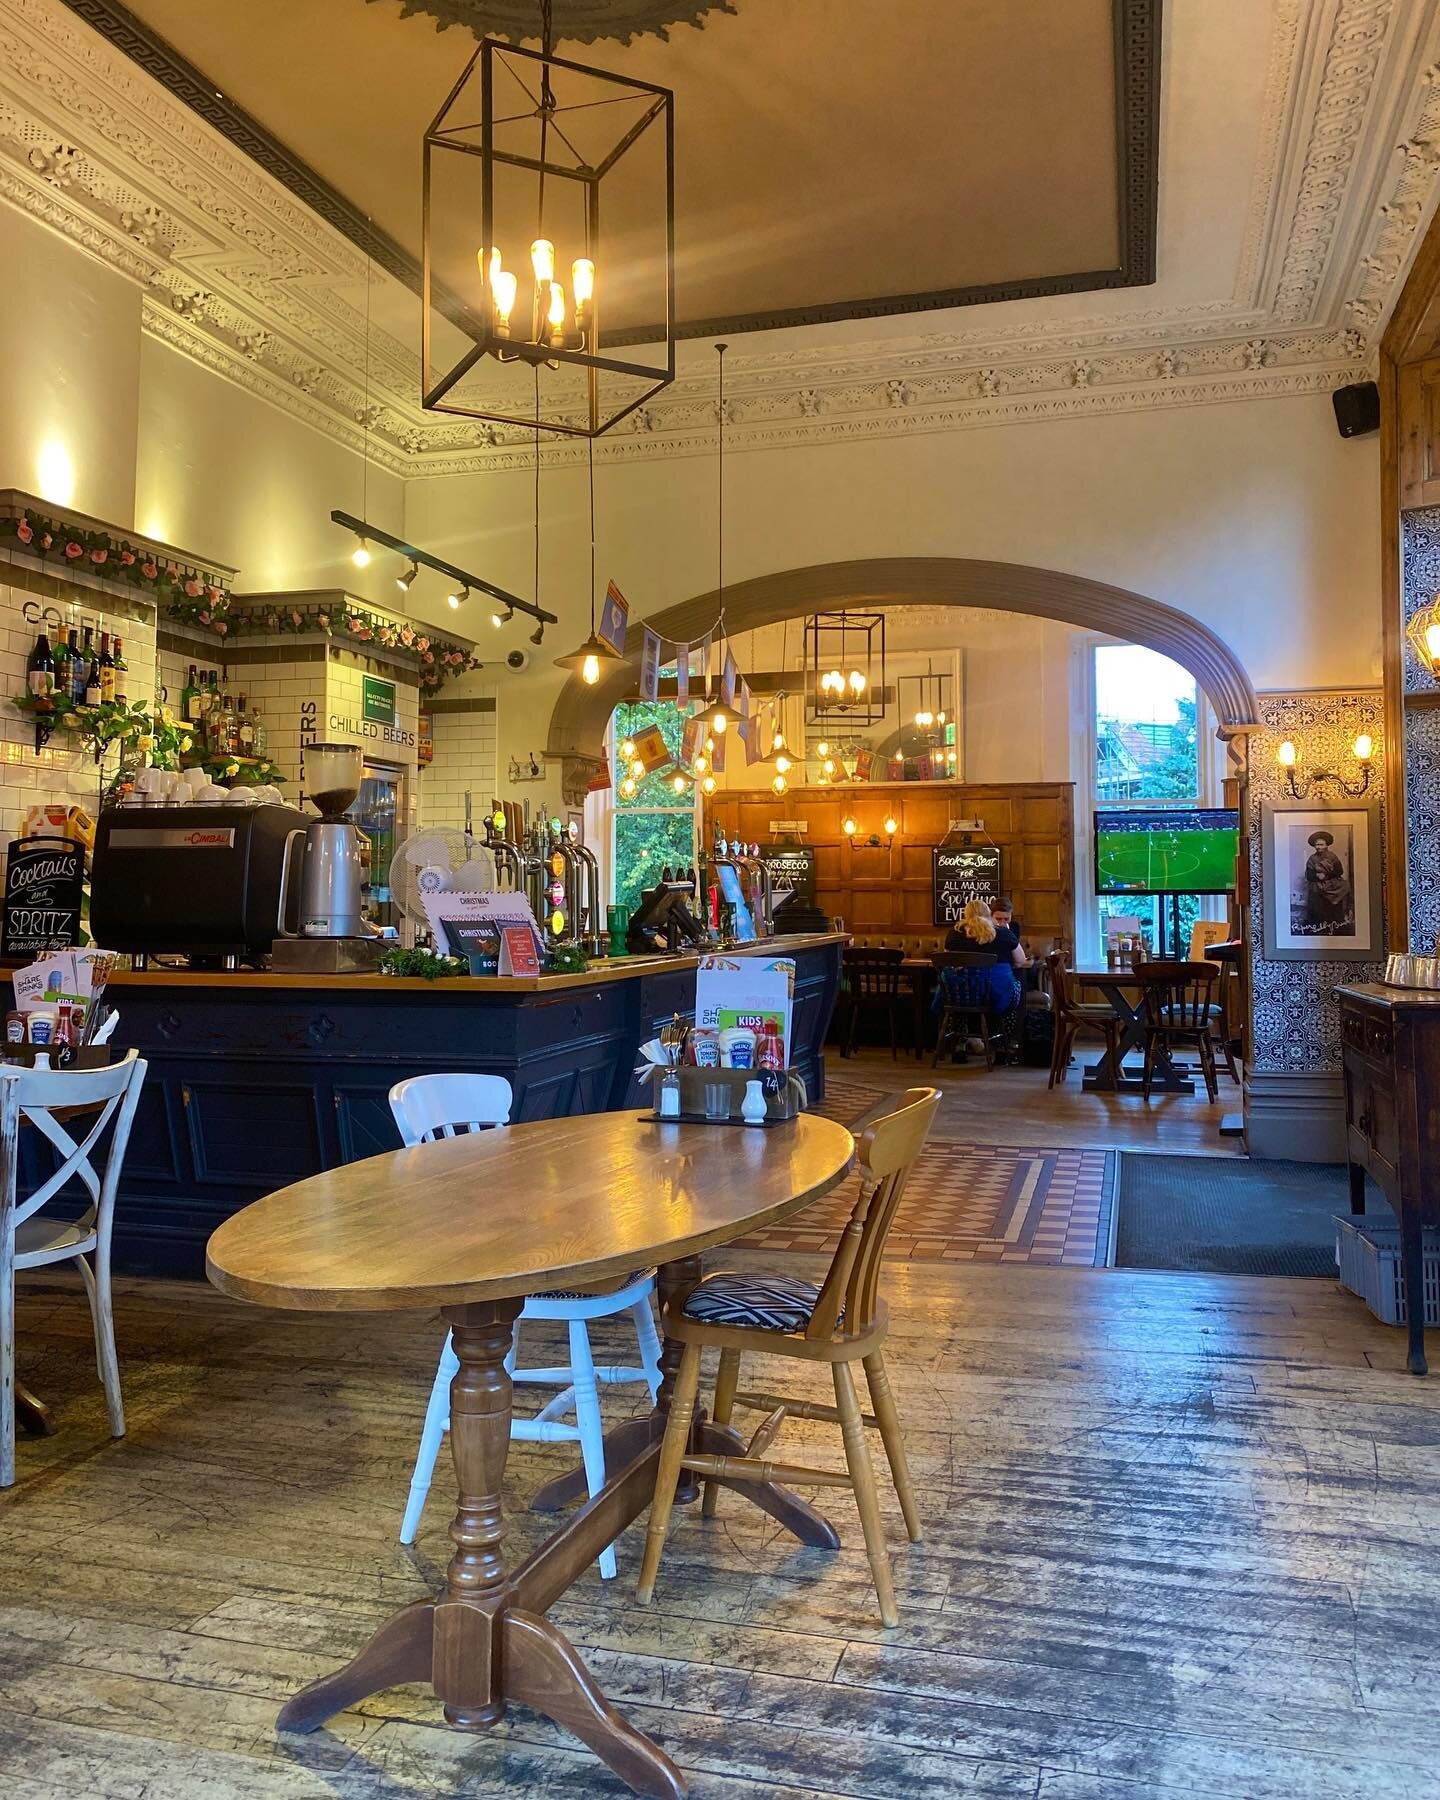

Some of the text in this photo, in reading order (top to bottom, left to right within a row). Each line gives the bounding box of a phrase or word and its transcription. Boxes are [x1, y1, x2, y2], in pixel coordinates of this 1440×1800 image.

[329, 715, 415, 747] CHILLED BEERS
[300, 702, 316, 781] ERS
[10, 856, 77, 889] Cocktails
[944, 881, 991, 891] ALL MAJOR
[31, 889, 48, 900] and
[459, 897, 490, 905] CHRISTMAS
[946, 907, 966, 921] EVE
[8, 910, 73, 936] SPRITZ
[458, 929, 495, 937] CHRISTMAS
[8, 940, 47, 951] available
[482, 960, 498, 968] BOO
[17, 974, 41, 988] SHARE
[17, 981, 43, 995] DRINKS
[702, 1017, 719, 1025] DRI
[738, 1016, 762, 1026] KIDS
